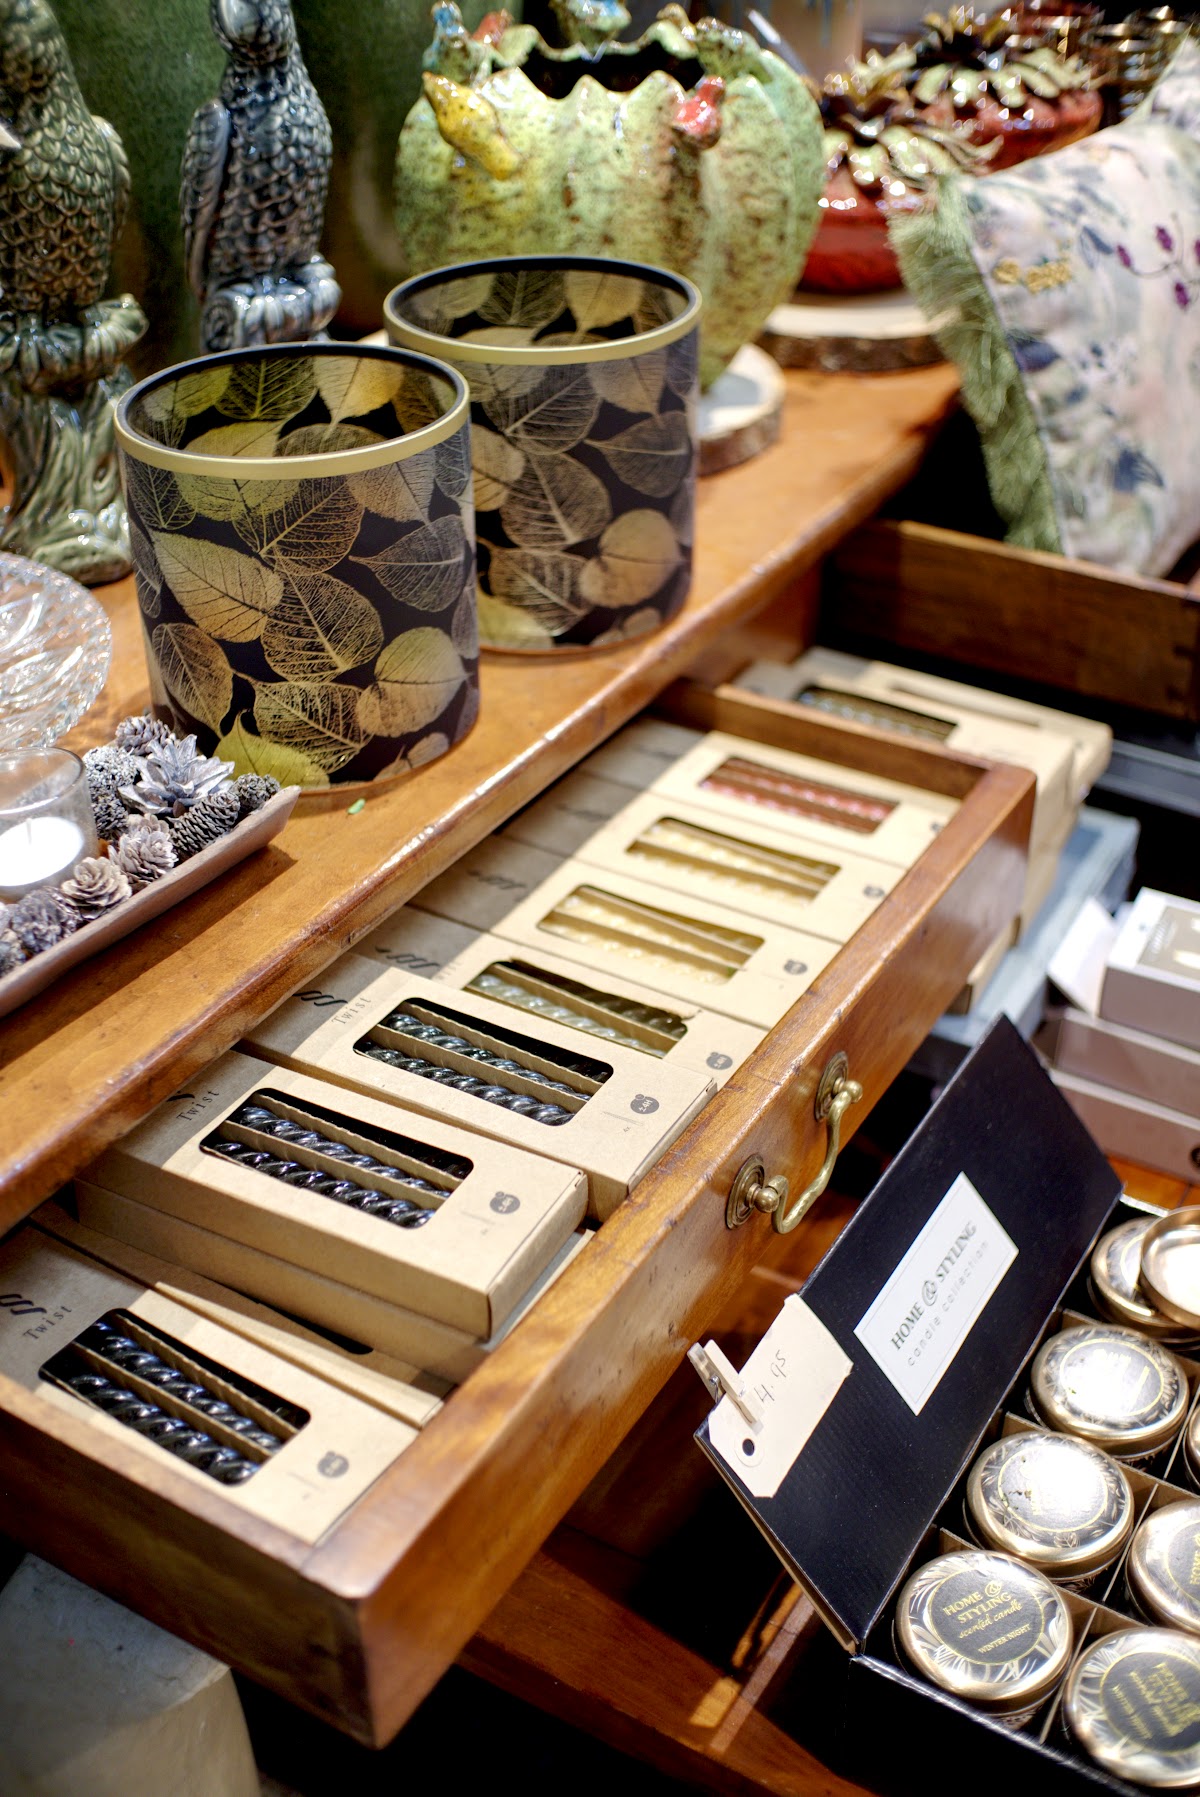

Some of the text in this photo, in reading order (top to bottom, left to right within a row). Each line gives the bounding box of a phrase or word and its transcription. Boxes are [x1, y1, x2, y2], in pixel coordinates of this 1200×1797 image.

[331, 997, 372, 1025] Twist
[176, 1090, 220, 1122] Twist
[890, 1302, 925, 1351] HOME
[935, 1220, 977, 1284] STYLING
[907, 1240, 989, 1367] candle collection
[22, 1305, 73, 1342] Twist
[753, 1349, 787, 1403] 4.95
[942, 1591, 984, 1617] HOME
[957, 1592, 1013, 1624] STYLING
[959, 1599, 1023, 1639] scented candle
[977, 1623, 1032, 1654] WINTER NIGHT
